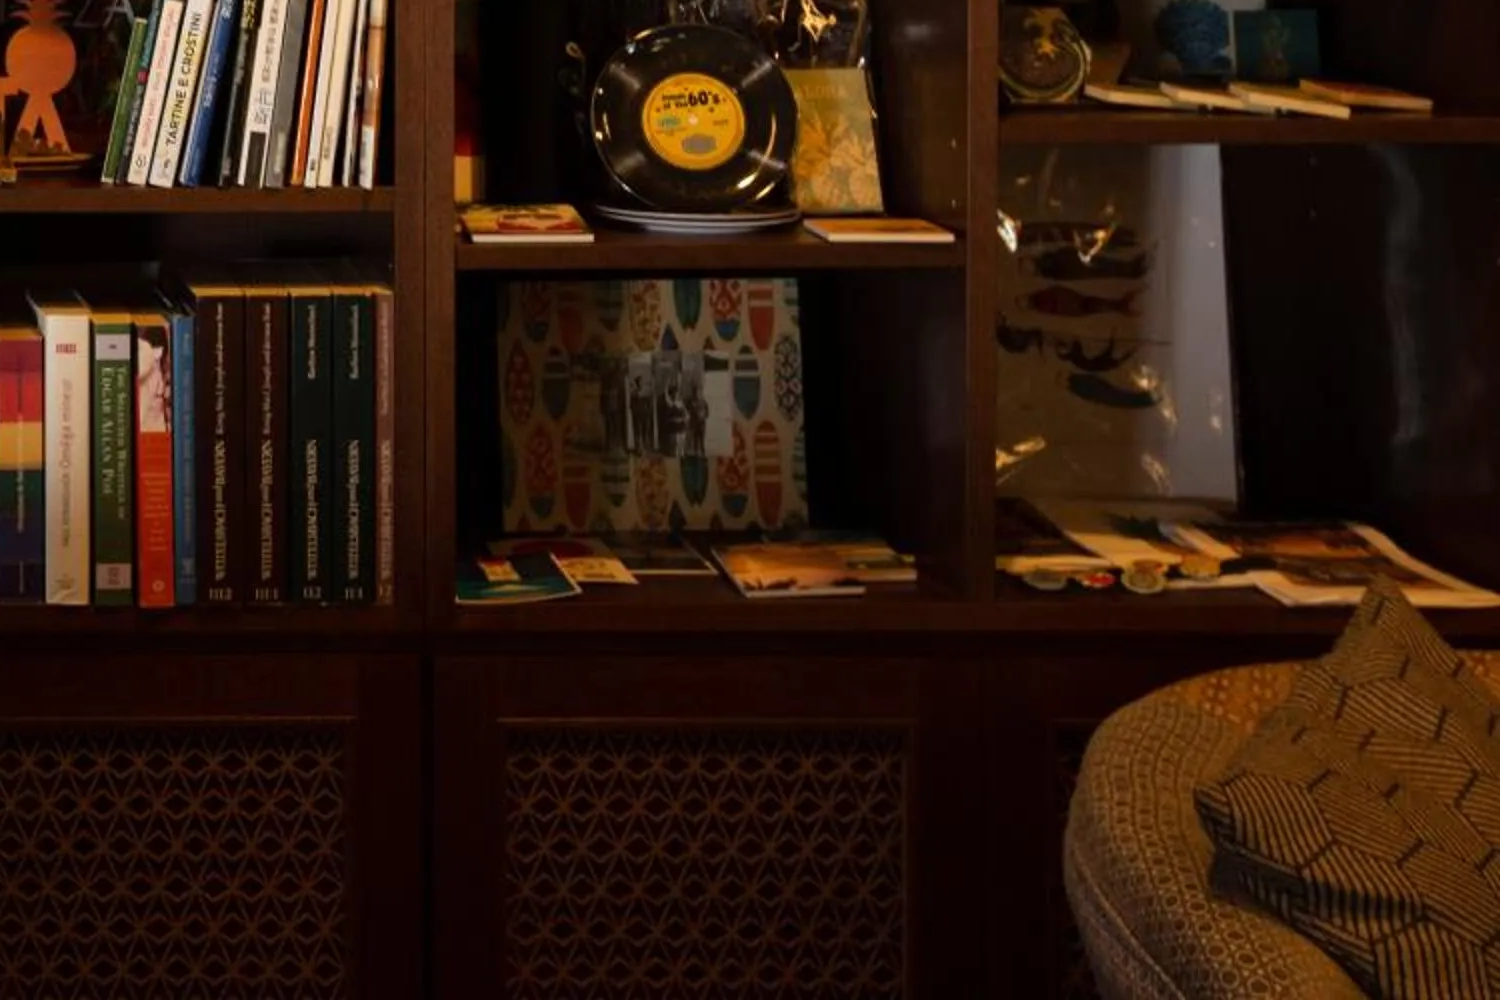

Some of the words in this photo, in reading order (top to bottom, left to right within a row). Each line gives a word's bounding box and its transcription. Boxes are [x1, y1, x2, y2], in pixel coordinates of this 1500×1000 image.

[165, 91, 187, 146] TARTINE
[180, 11, 202, 75] CROSTINI
[100, 367, 115, 414] EDGAR
[101, 417, 115, 464] ALLAN
[101, 468, 115, 495] POE
